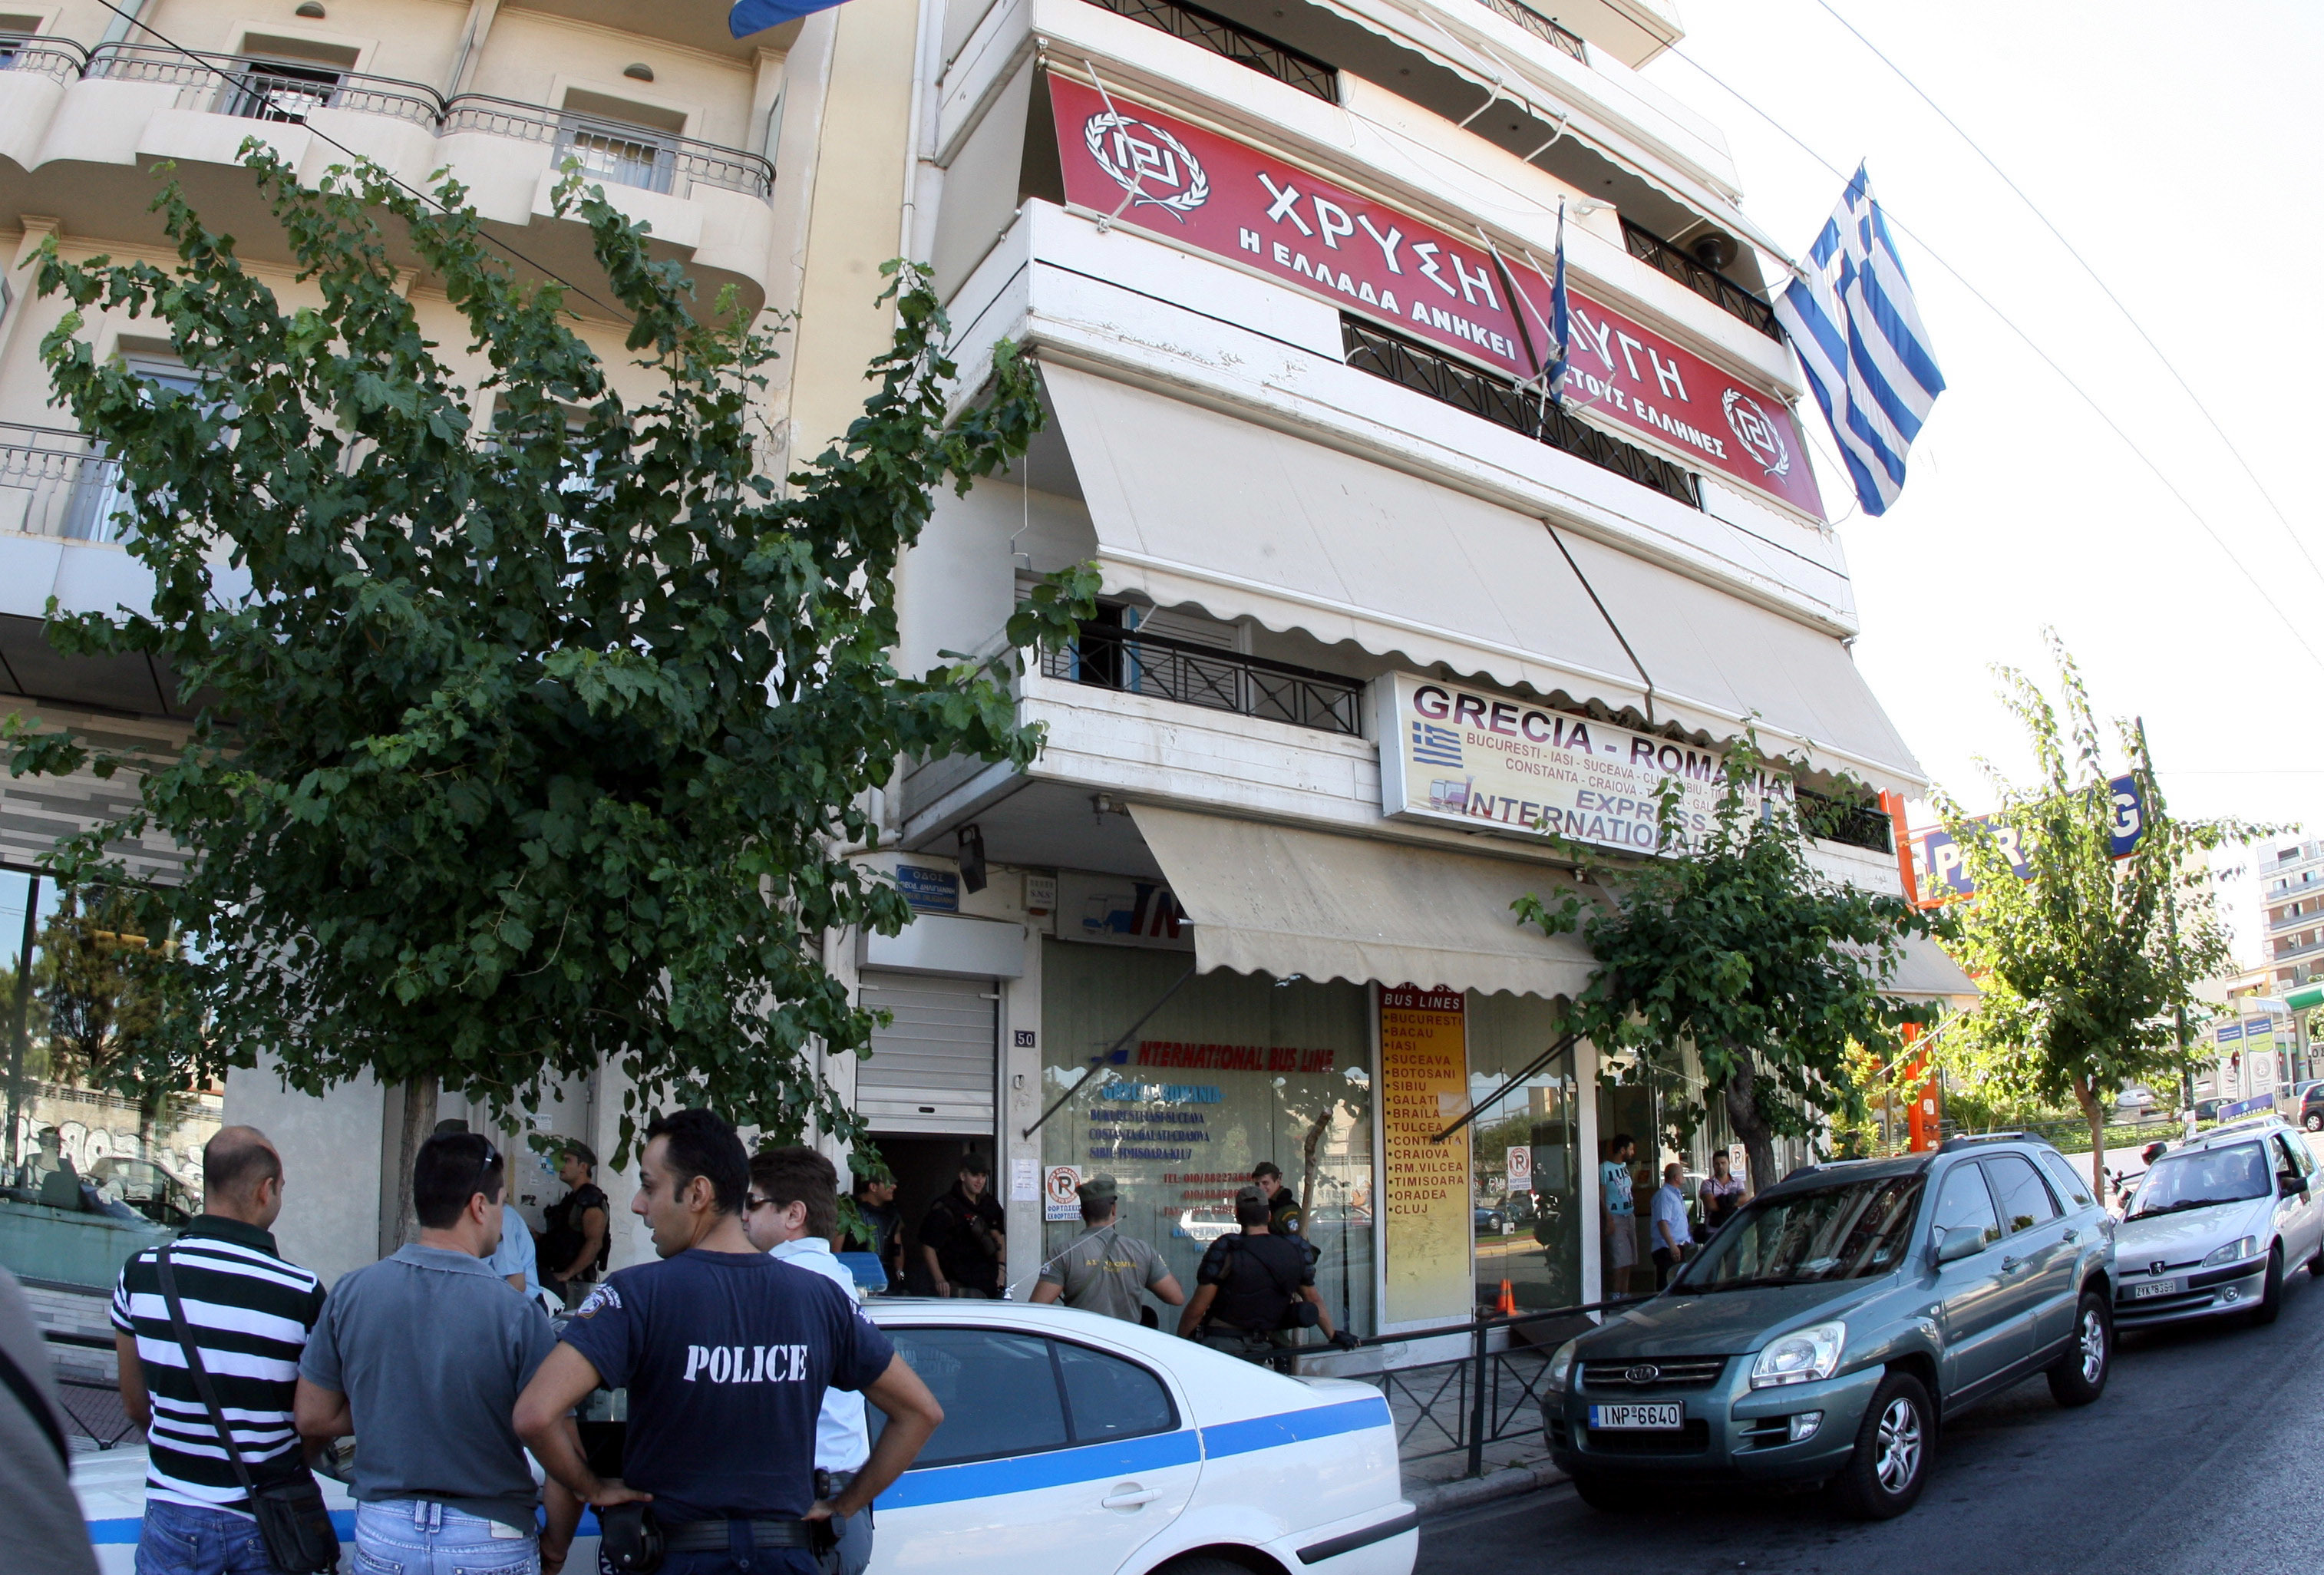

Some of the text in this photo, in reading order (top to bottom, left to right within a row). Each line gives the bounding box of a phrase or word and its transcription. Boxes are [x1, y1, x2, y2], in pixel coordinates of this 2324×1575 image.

[1256, 172, 1502, 312] ΧΡΥΣΗ
[1240, 227, 1260, 254] Η
[1273, 241, 1401, 315] ΕΛΛΑΔΑ
[1411, 301, 1516, 361] ΑΝΗΚΕΙ
[1632, 397, 1728, 460] ΕΛΛΗΝΕΣ
[1413, 685, 1593, 754] GRECIA
[1467, 732, 1540, 759] BUCURESTI
[1550, 751, 1573, 767] IASI
[1583, 759, 1634, 780] SUCEAVA
[1643, 772, 1660, 785] CLU
[1684, 781, 1702, 795] IBIU
[1711, 788, 1757, 807] TIMIRA
[1505, 758, 1579, 784] CONSTANTA
[1588, 777, 1637, 796] CRAIOVA
[1693, 798, 1719, 813] GAL
[1576, 789, 1706, 832] EXPRSS
[913, 870, 944, 882] ΟΔΟΣ
[1384, 993, 1460, 1009] BUS LINES
[1390, 1012, 1462, 1026] BUCURESTI
[1018, 1032, 1033, 1045] 50
[1390, 1027, 1434, 1038] BACAU
[1391, 1041, 1416, 1051] IASI
[1268, 1047, 1297, 1072] BUS
[1300, 1048, 1335, 1073] LINE
[1391, 1054, 1451, 1065] SUCEAVA
[1391, 1068, 1456, 1079] BOTOSANI
[1392, 1081, 1426, 1091] SIBIU
[1392, 1095, 1438, 1105] GALATI
[1393, 1108, 1441, 1118] BRAILA
[1392, 1122, 1444, 1132] TULCEA
[1394, 1149, 1450, 1160] CRAIOVA
[1395, 1162, 1463, 1174] RM.VILCEA
[1394, 1175, 1464, 1187] TIMISOARA
[1395, 1190, 1447, 1200] ORADEA
[1395, 1204, 1428, 1214] CLUJ
[683, 1344, 808, 1383] POLICE
